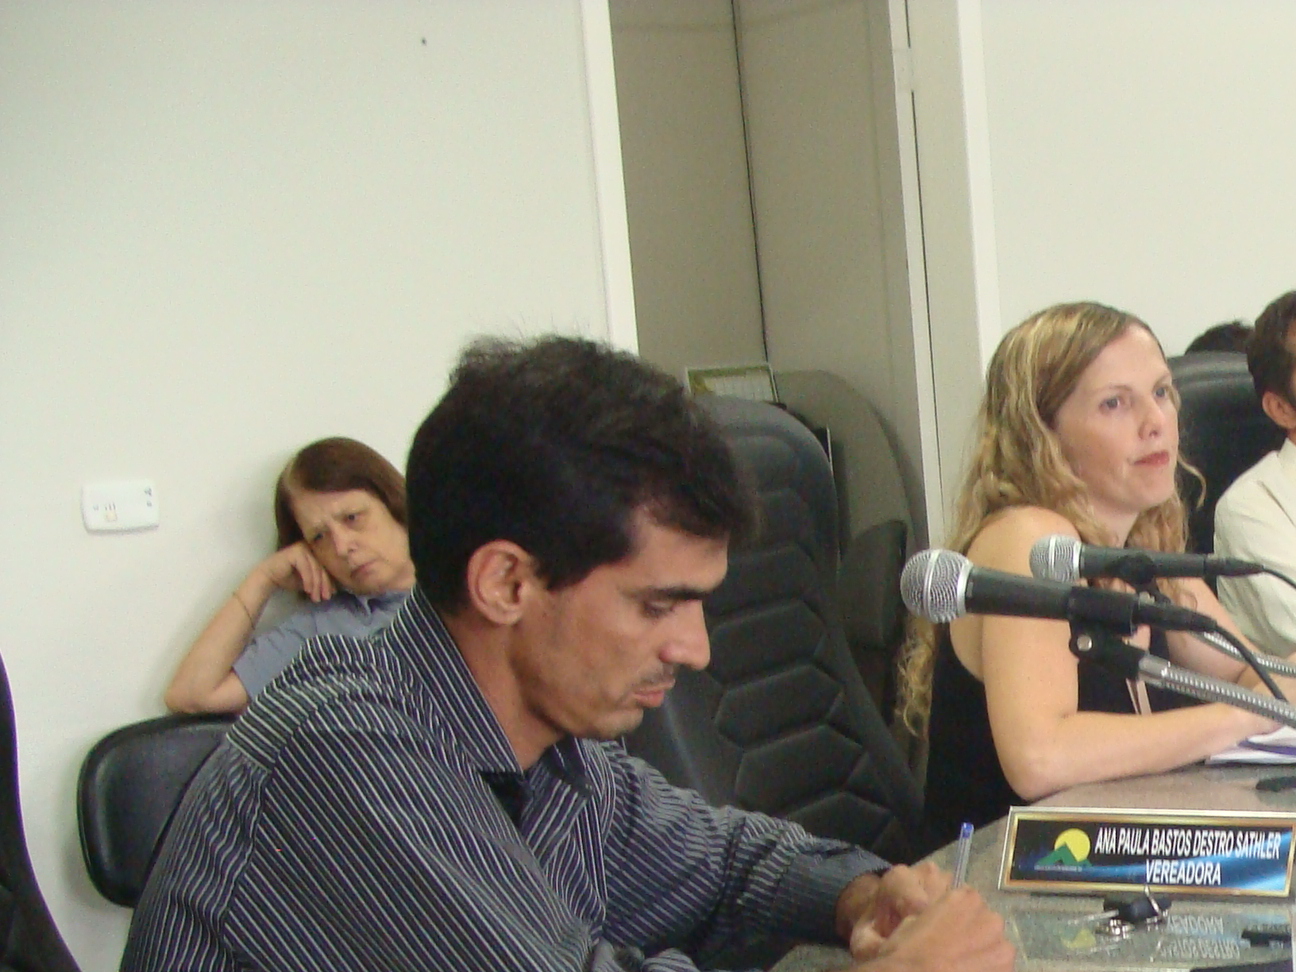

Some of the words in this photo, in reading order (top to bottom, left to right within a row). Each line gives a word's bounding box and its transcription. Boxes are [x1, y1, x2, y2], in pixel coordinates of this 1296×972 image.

[1094, 827, 1116, 853] ANA
[1118, 828, 1150, 856] PAULA
[1151, 829, 1192, 857] BASTOS
[1192, 830, 1235, 859] DESTRO
[1235, 831, 1281, 860] SATHLER
[1145, 859, 1222, 886] VEREADORA
